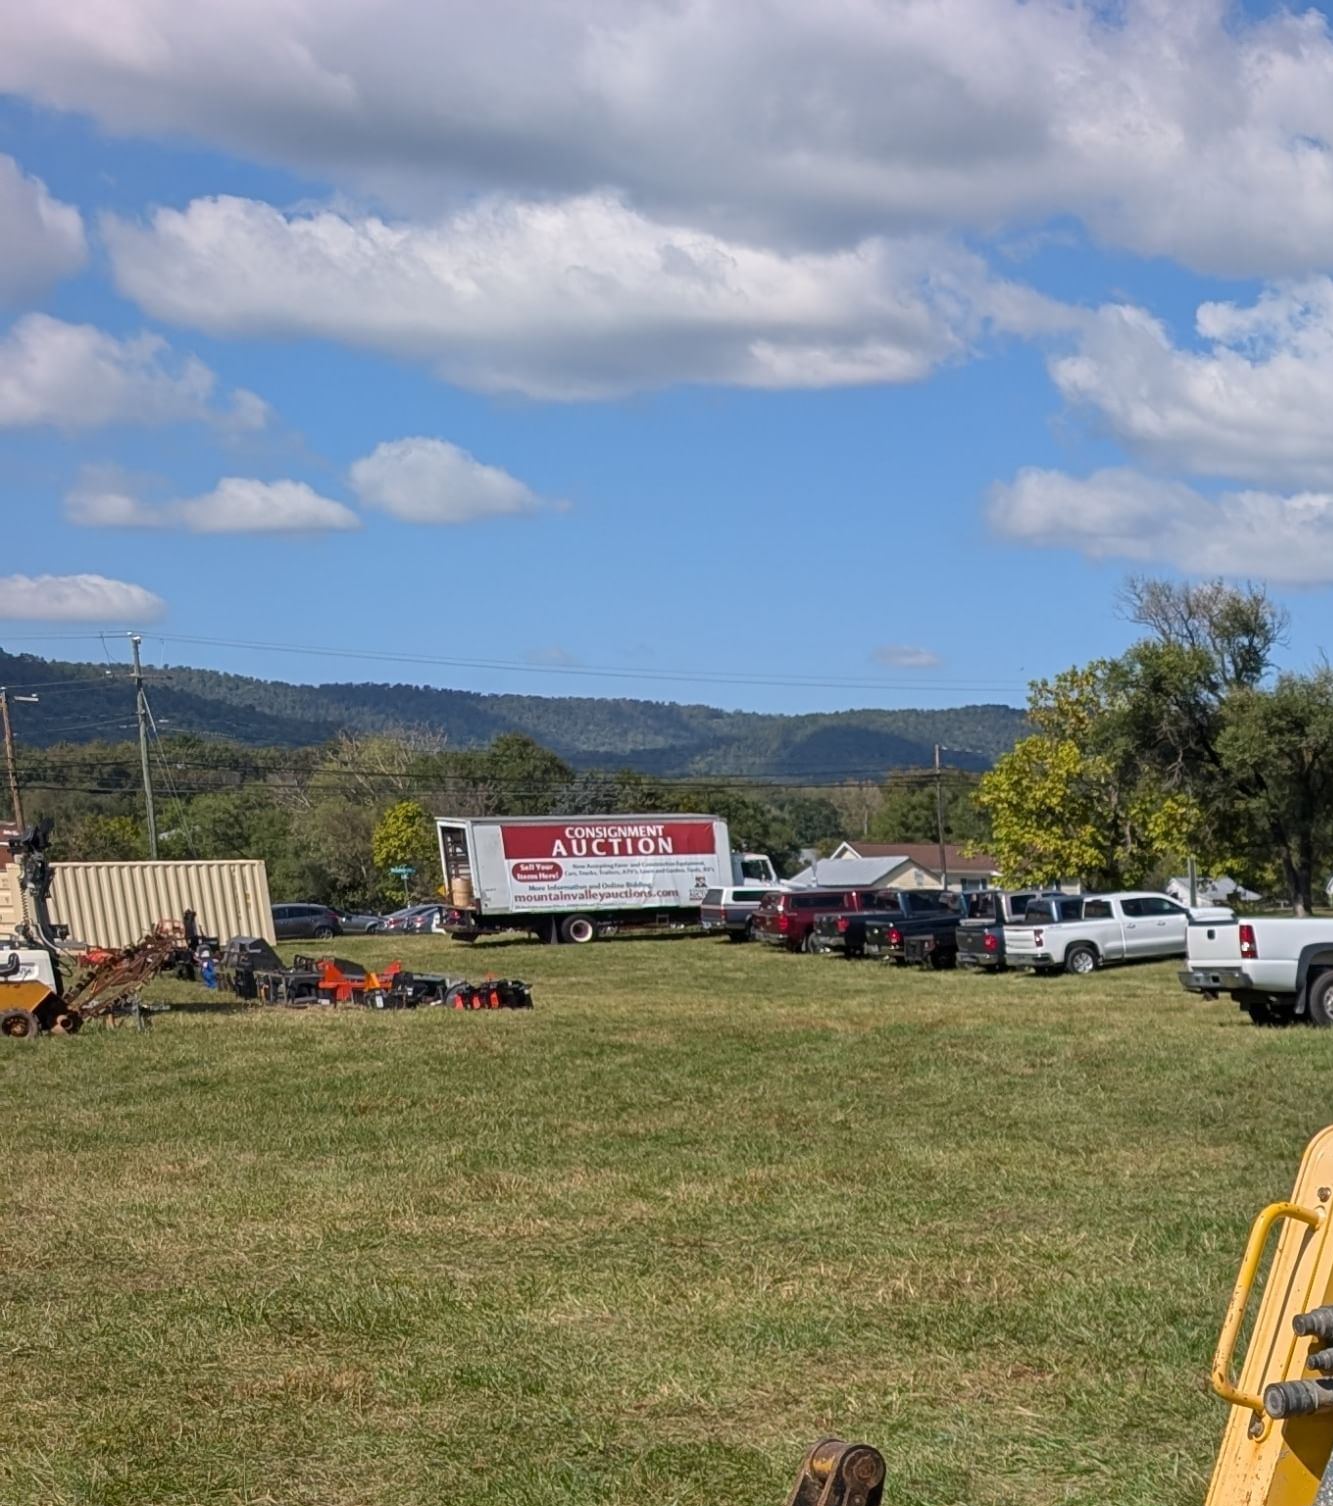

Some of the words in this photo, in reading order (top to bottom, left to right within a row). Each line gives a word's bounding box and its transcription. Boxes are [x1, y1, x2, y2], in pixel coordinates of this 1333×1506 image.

[565, 825, 664, 839] CONSIGNMENT
[552, 837, 673, 857] AUCTION
[519, 863, 535, 871] Sell
[535, 863, 554, 871] Your
[517, 872, 538, 880] Items
[539, 871, 560, 880] Here!
[514, 887, 679, 902] mountainvalleyauctions.com
